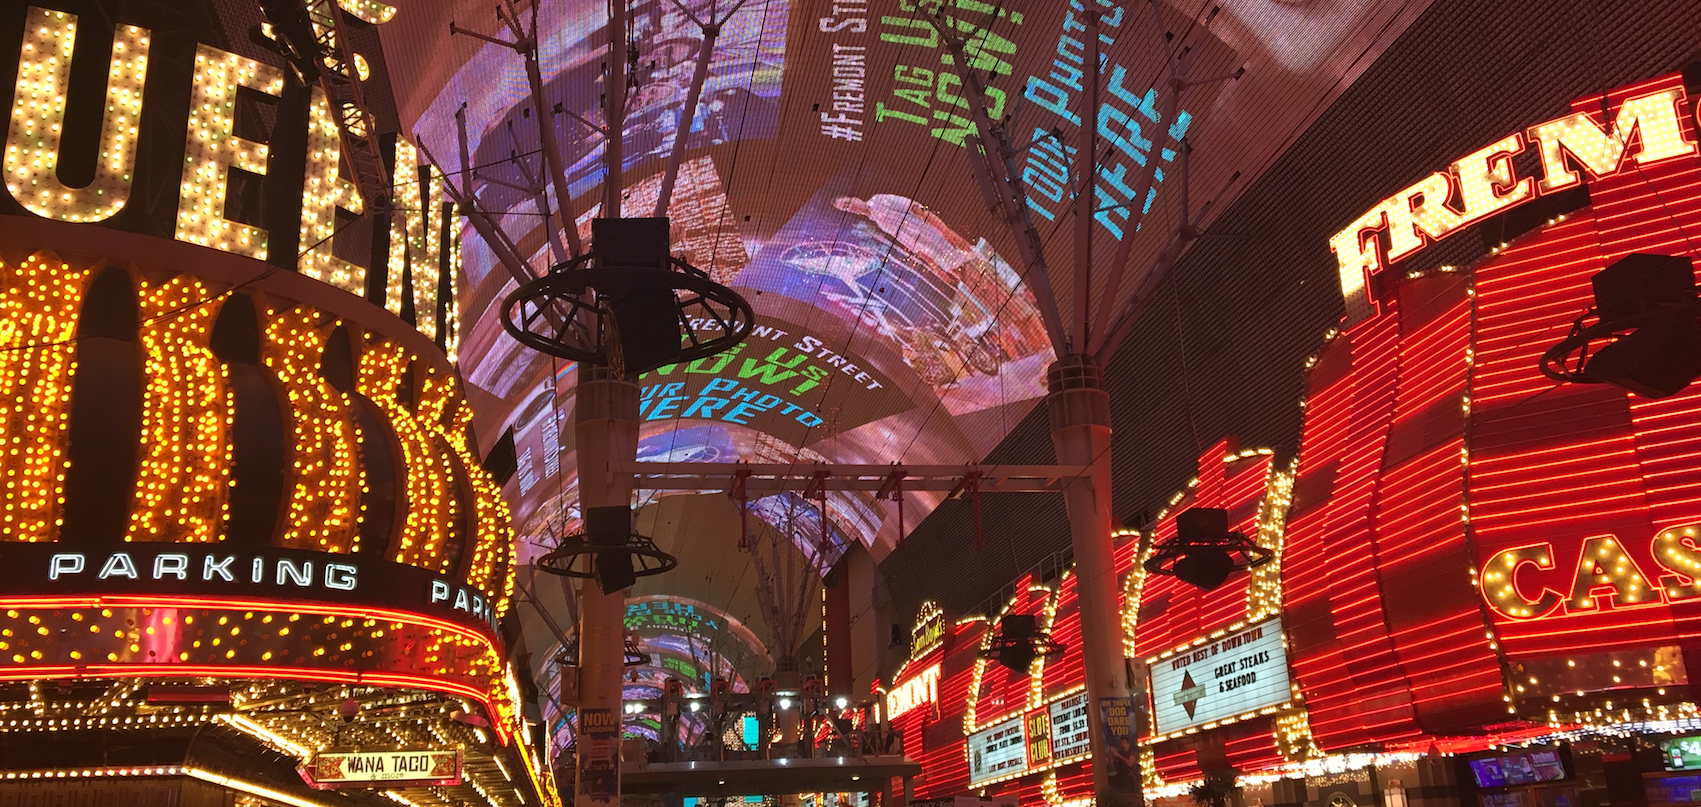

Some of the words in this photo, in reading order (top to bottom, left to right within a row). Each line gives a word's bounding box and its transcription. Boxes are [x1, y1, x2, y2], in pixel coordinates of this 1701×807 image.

[820, 43, 865, 142] #FREMONT
[875, 64, 935, 126] TAG
[1329, 84, 1701, 336] FREM
[764, 346, 829, 382] US
[793, 335, 884, 391] STREET
[698, 377, 824, 428] PHOTO
[50, 552, 358, 591] PARKING
[1171, 656, 1192, 671] VOTED
[1192, 648, 1209, 663] BEST
[1211, 643, 1219, 655] OF
[1221, 626, 1264, 653] DOWNTOWN
[1214, 661, 1237, 679] GREAT
[1239, 650, 1270, 671] STEAKS
[1218, 681, 1225, 693] &
[1225, 671, 1257, 692] SEAFOOD
[583, 712, 615, 727] NOW
[1108, 717, 1129, 726] DARE
[1109, 707, 1126, 716] DOG
[1028, 714, 1047, 739] SLOT
[1110, 727, 1128, 735] YOU
[347, 756, 385, 773] WANA
[391, 754, 430, 773] TACO
[1030, 738, 1050, 764] CLUB
[370, 772, 377, 782] &
[381, 771, 404, 780] more
